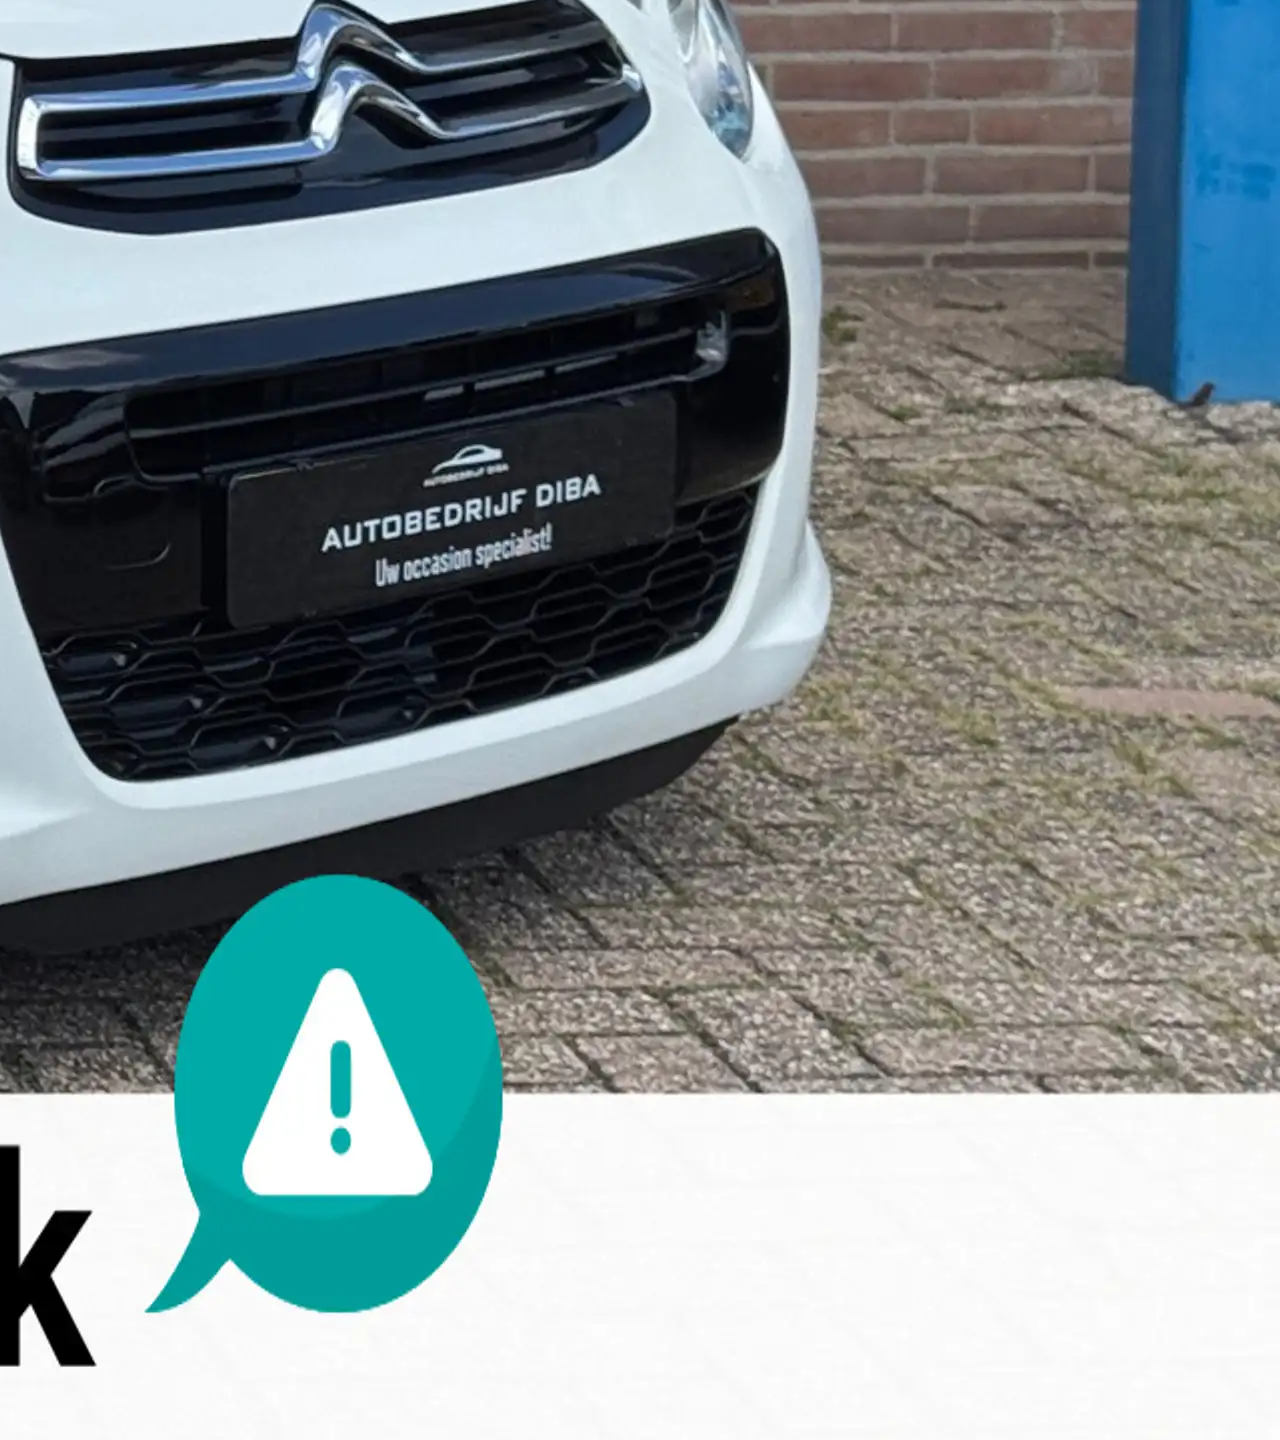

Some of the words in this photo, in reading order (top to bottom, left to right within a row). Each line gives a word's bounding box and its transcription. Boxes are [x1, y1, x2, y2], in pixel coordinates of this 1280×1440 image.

[321, 489, 527, 553] AUTOBEDRIJF
[535, 473, 602, 509] DIBA
[375, 557, 400, 588] Uw
[403, 545, 474, 582] occasion
[475, 521, 553, 570] specialist!
